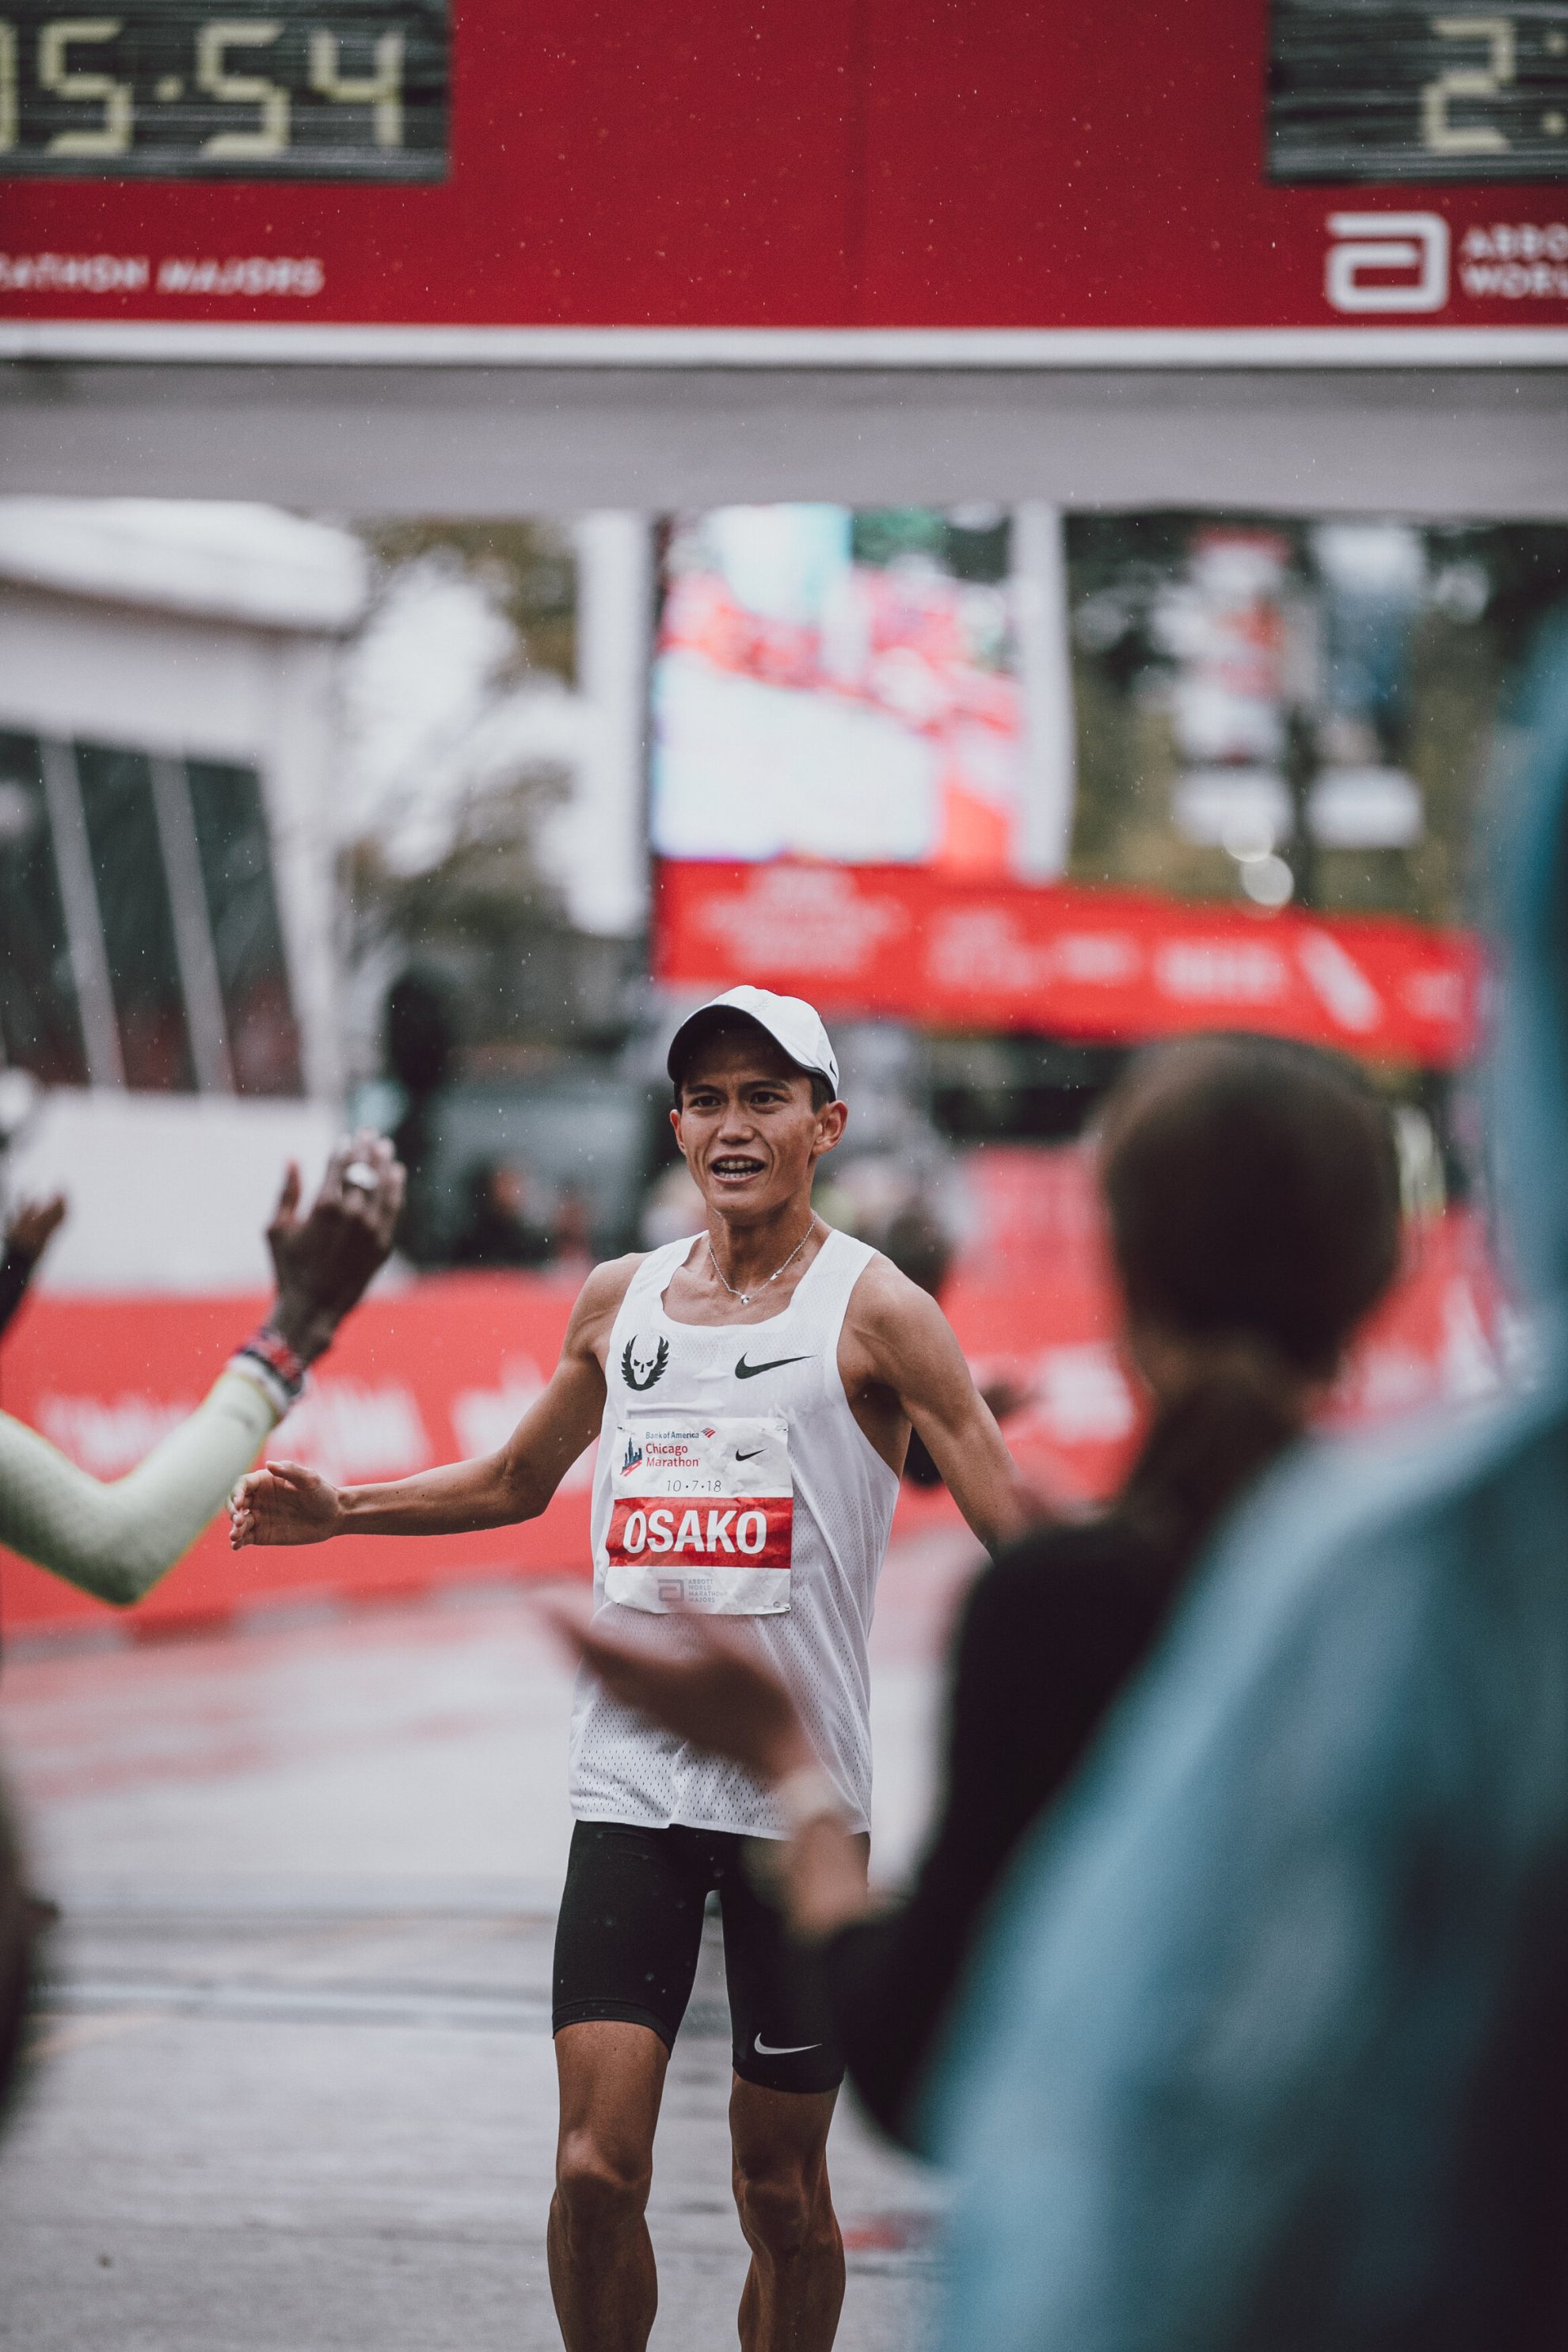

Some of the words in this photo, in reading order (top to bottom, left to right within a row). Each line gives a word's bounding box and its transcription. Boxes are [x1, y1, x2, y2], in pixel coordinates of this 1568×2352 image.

[157, 257, 324, 296] MAJORS
[646, 1444, 687, 1456] Chicago
[646, 1457, 698, 1467] Marathon
[622, 1509, 767, 1555] OSAKO
